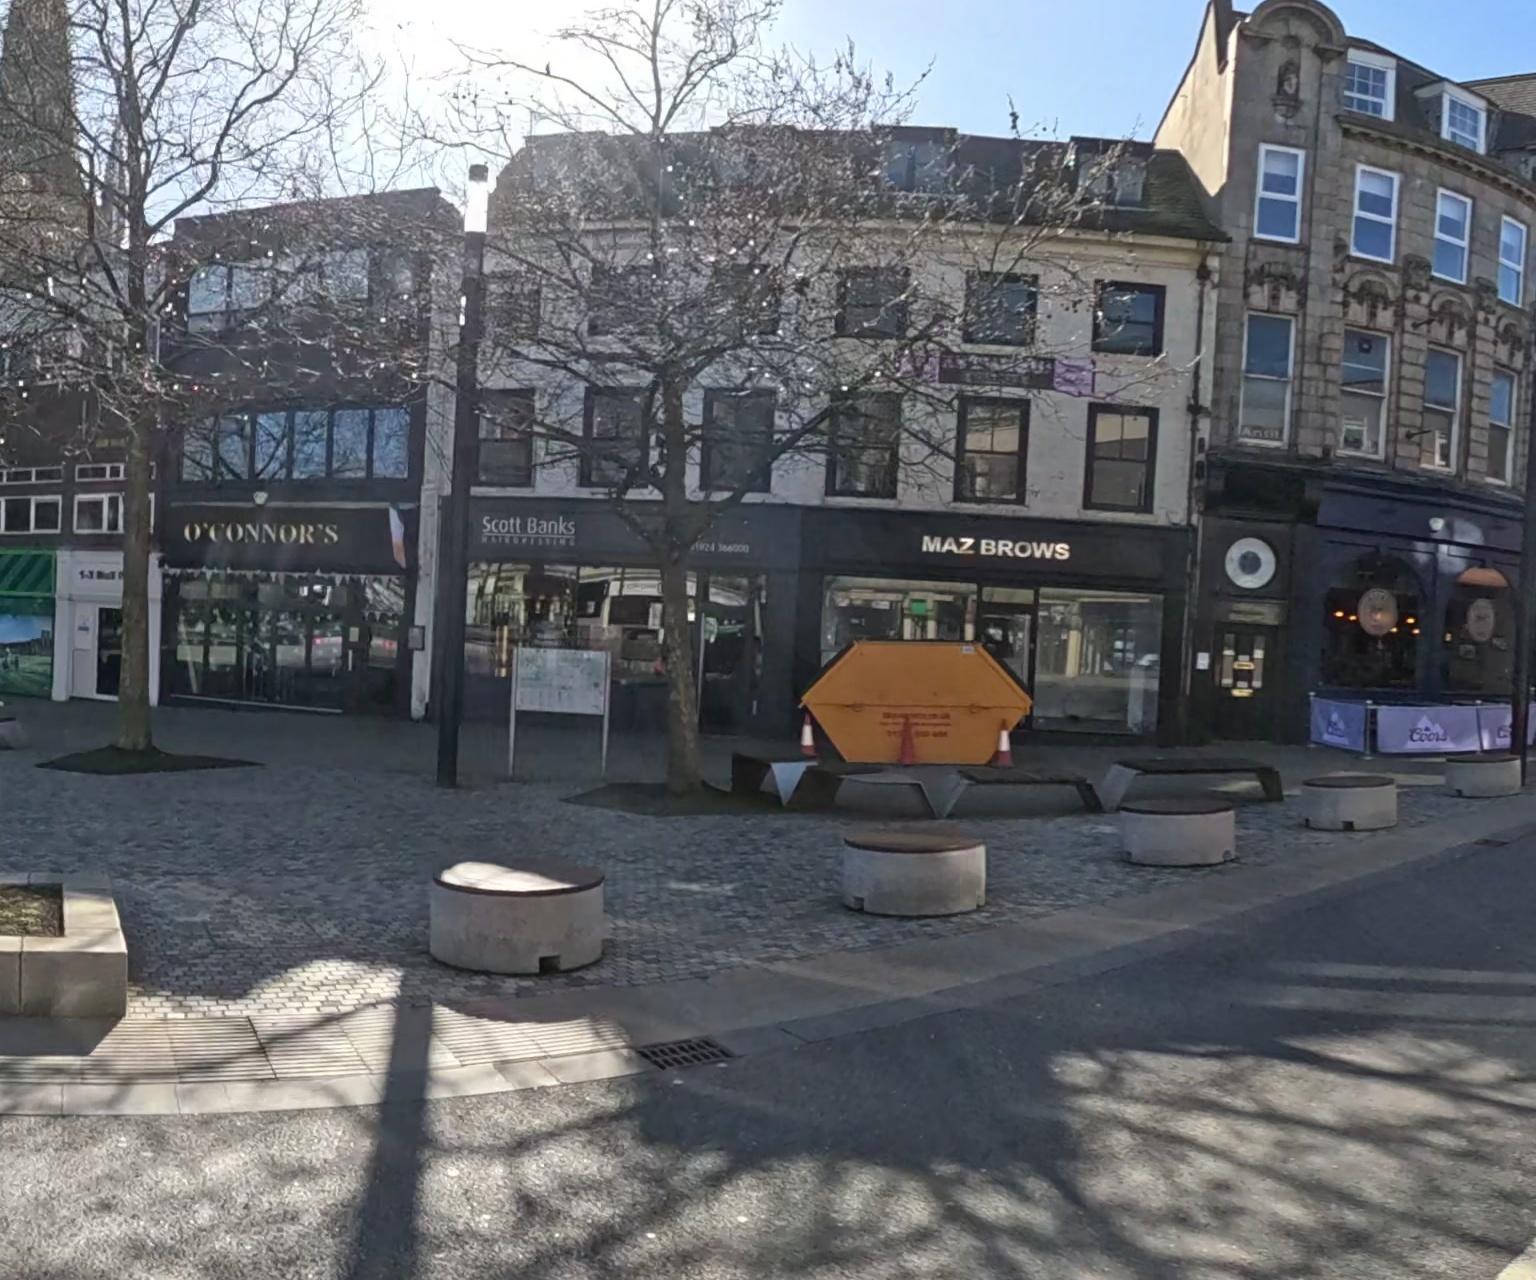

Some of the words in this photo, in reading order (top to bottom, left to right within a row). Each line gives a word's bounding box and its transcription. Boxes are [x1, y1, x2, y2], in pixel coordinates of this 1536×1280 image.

[183, 523, 339, 545] O'CONNOR'S
[482, 515, 522, 534] Scott
[528, 516, 576, 536] Banks
[921, 535, 975, 555] MAZ
[979, 538, 1071, 560] BROWS
[1409, 726, 1448, 742] Coors
